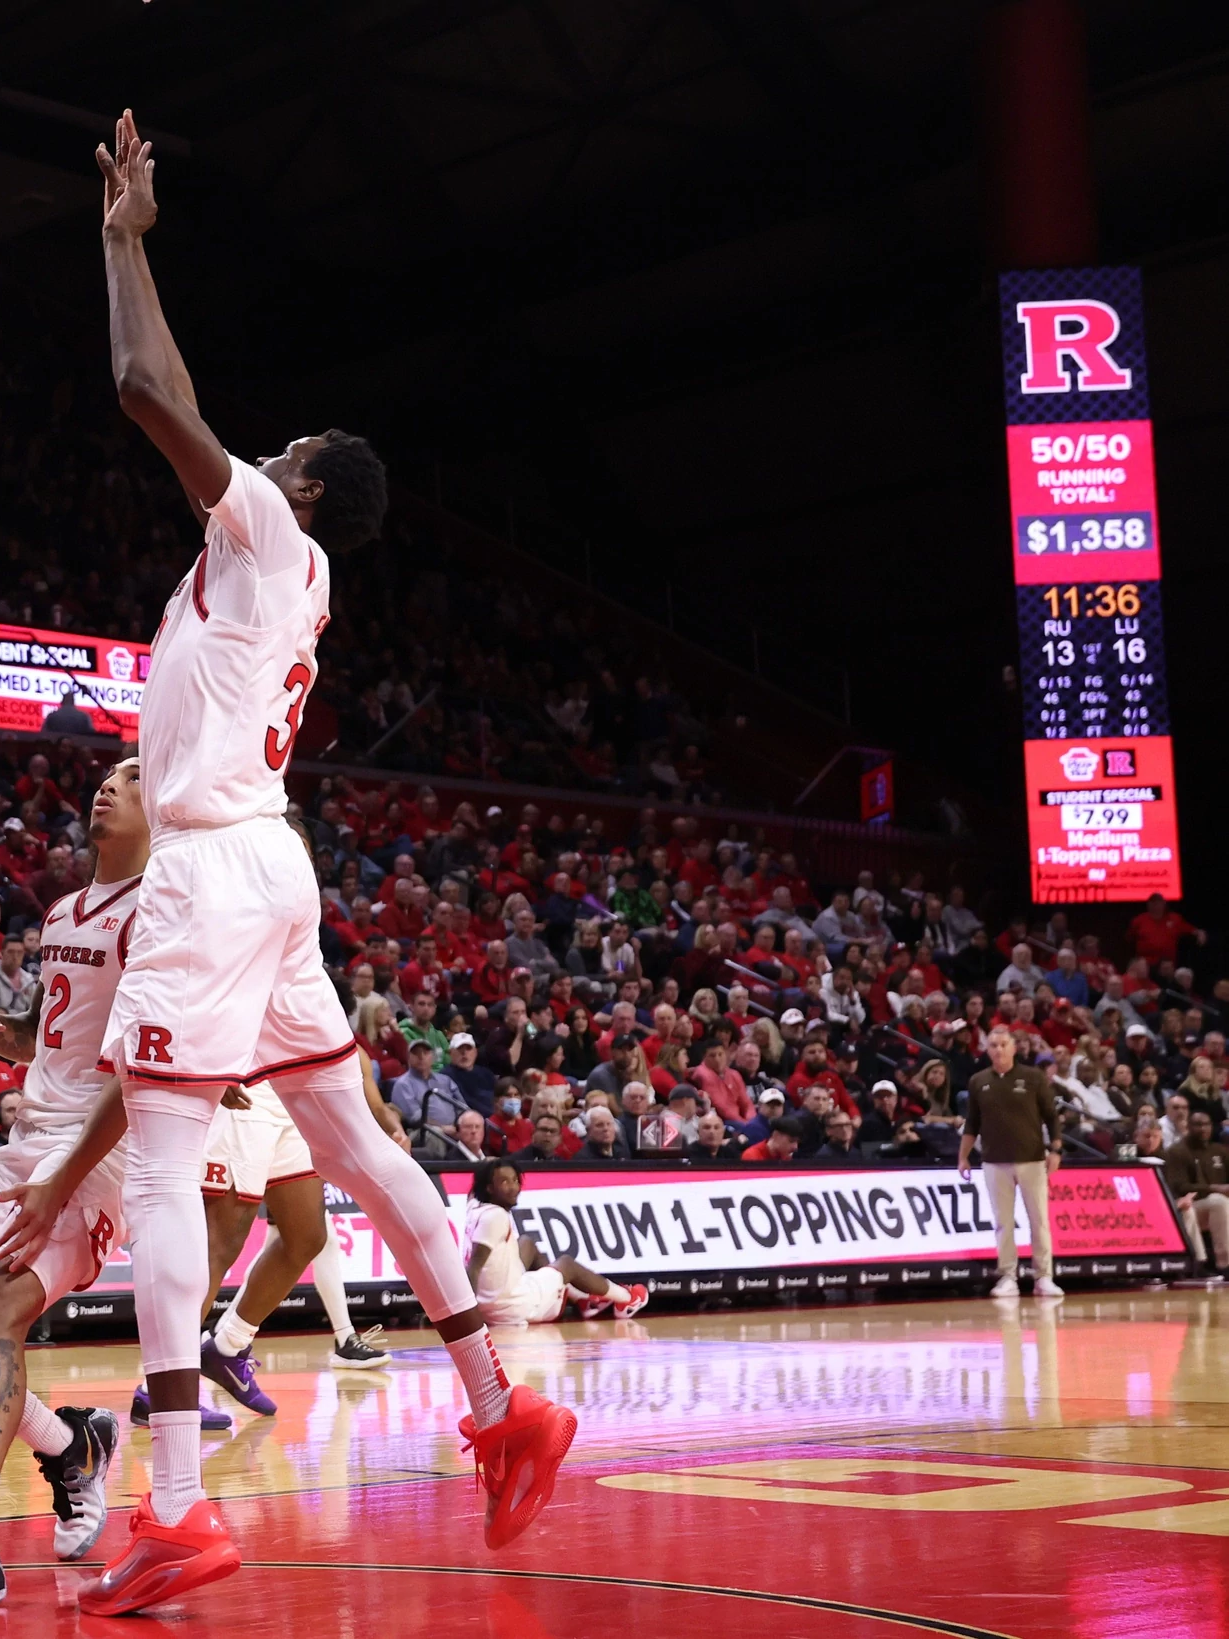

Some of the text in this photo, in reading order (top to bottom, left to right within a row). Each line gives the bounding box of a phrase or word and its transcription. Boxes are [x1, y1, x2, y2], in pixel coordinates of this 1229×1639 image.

[1017, 299, 1132, 394] R
[1031, 434, 1131, 463] 50/50
[1037, 468, 1126, 487] RUNNING
[1027, 518, 1146, 555] $1,358
[1043, 584, 1141, 618] 11:36
[1043, 618, 1139, 637] RU LU
[1041, 640, 1075, 667] 13
[1112, 637, 1147, 664] 16
[1106, 751, 1135, 776] R
[1046, 787, 1155, 806] STUDENT SPECIAL
[1067, 830, 1140, 849] Medium
[1122, 845, 1171, 862] Pizza
[43, 973, 71, 1050] 2
[134, 1024, 174, 1064] R
[205, 1161, 227, 1185] R
[89, 1208, 115, 1256] R
[511, 1183, 1020, 1262] EDIUM 1-TOPPING PIZZ
[79, 1304, 114, 1316] Prudential
[392, 1293, 422, 1303] Prudentia
